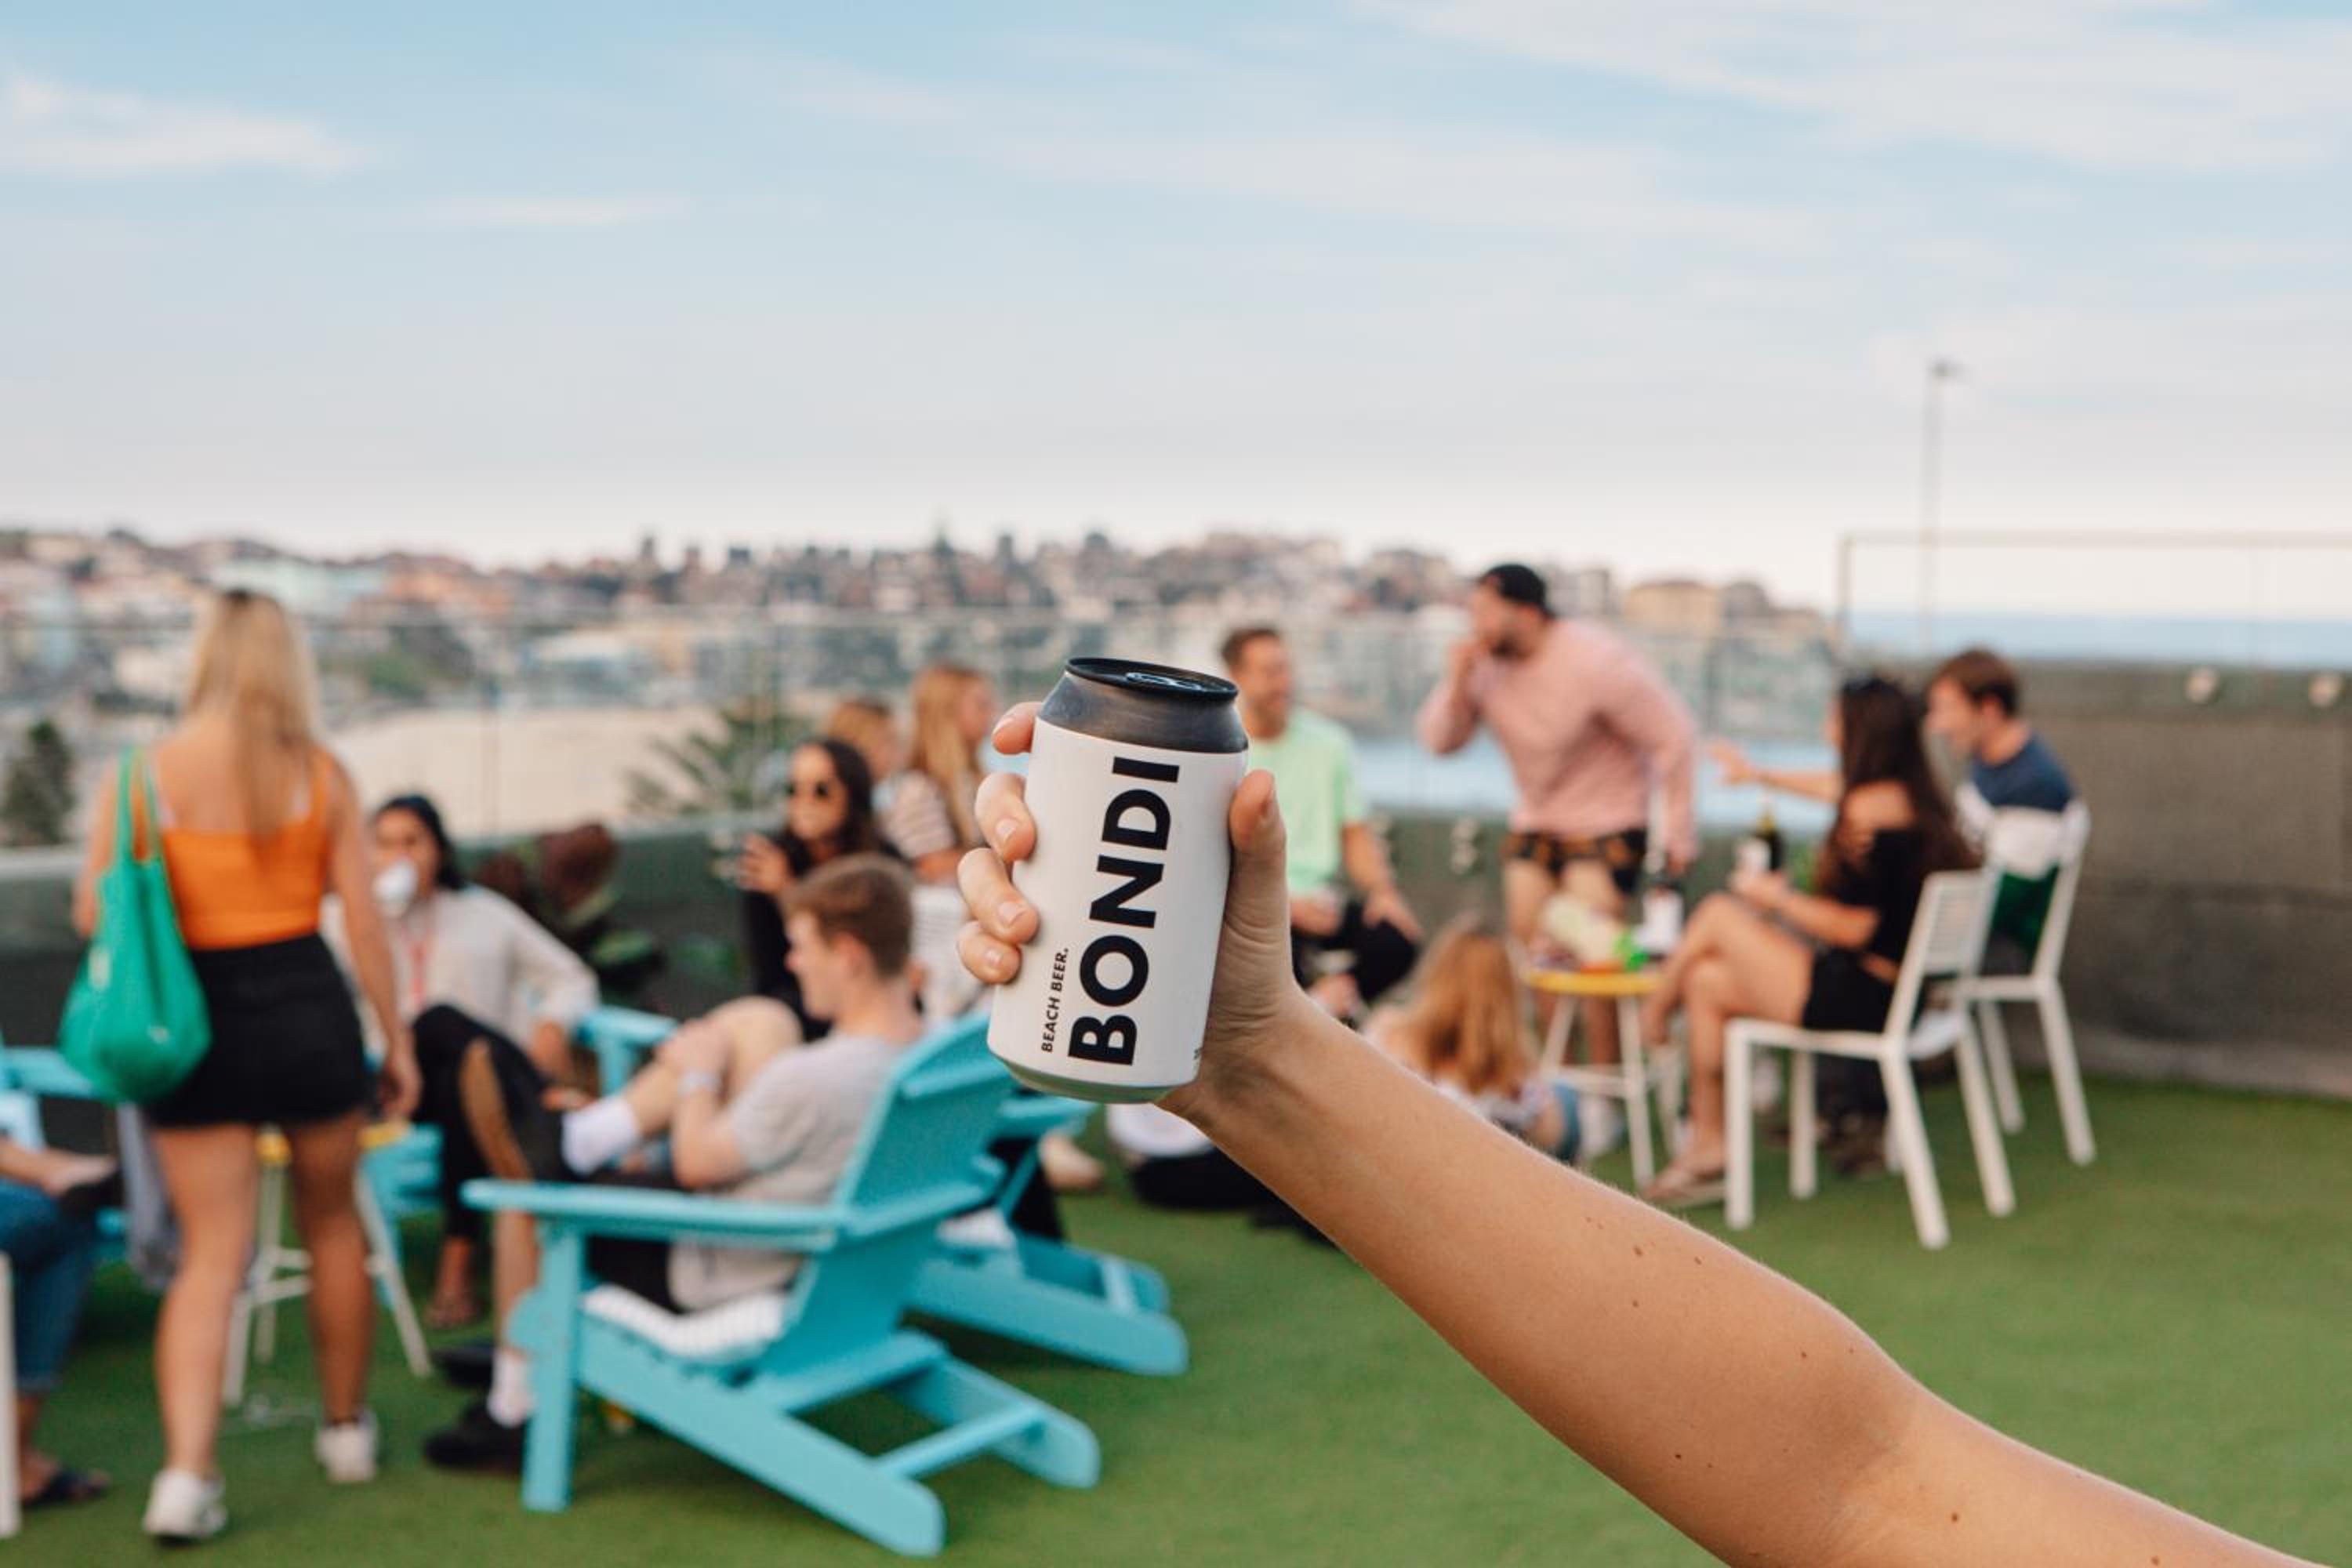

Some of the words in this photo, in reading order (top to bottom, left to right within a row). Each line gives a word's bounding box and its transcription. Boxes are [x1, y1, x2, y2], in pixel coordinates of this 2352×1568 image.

[1041, 996, 1061, 1052] BEACH
[1051, 948, 1069, 992] BEER.
[1068, 757, 1179, 1065] BONDI
